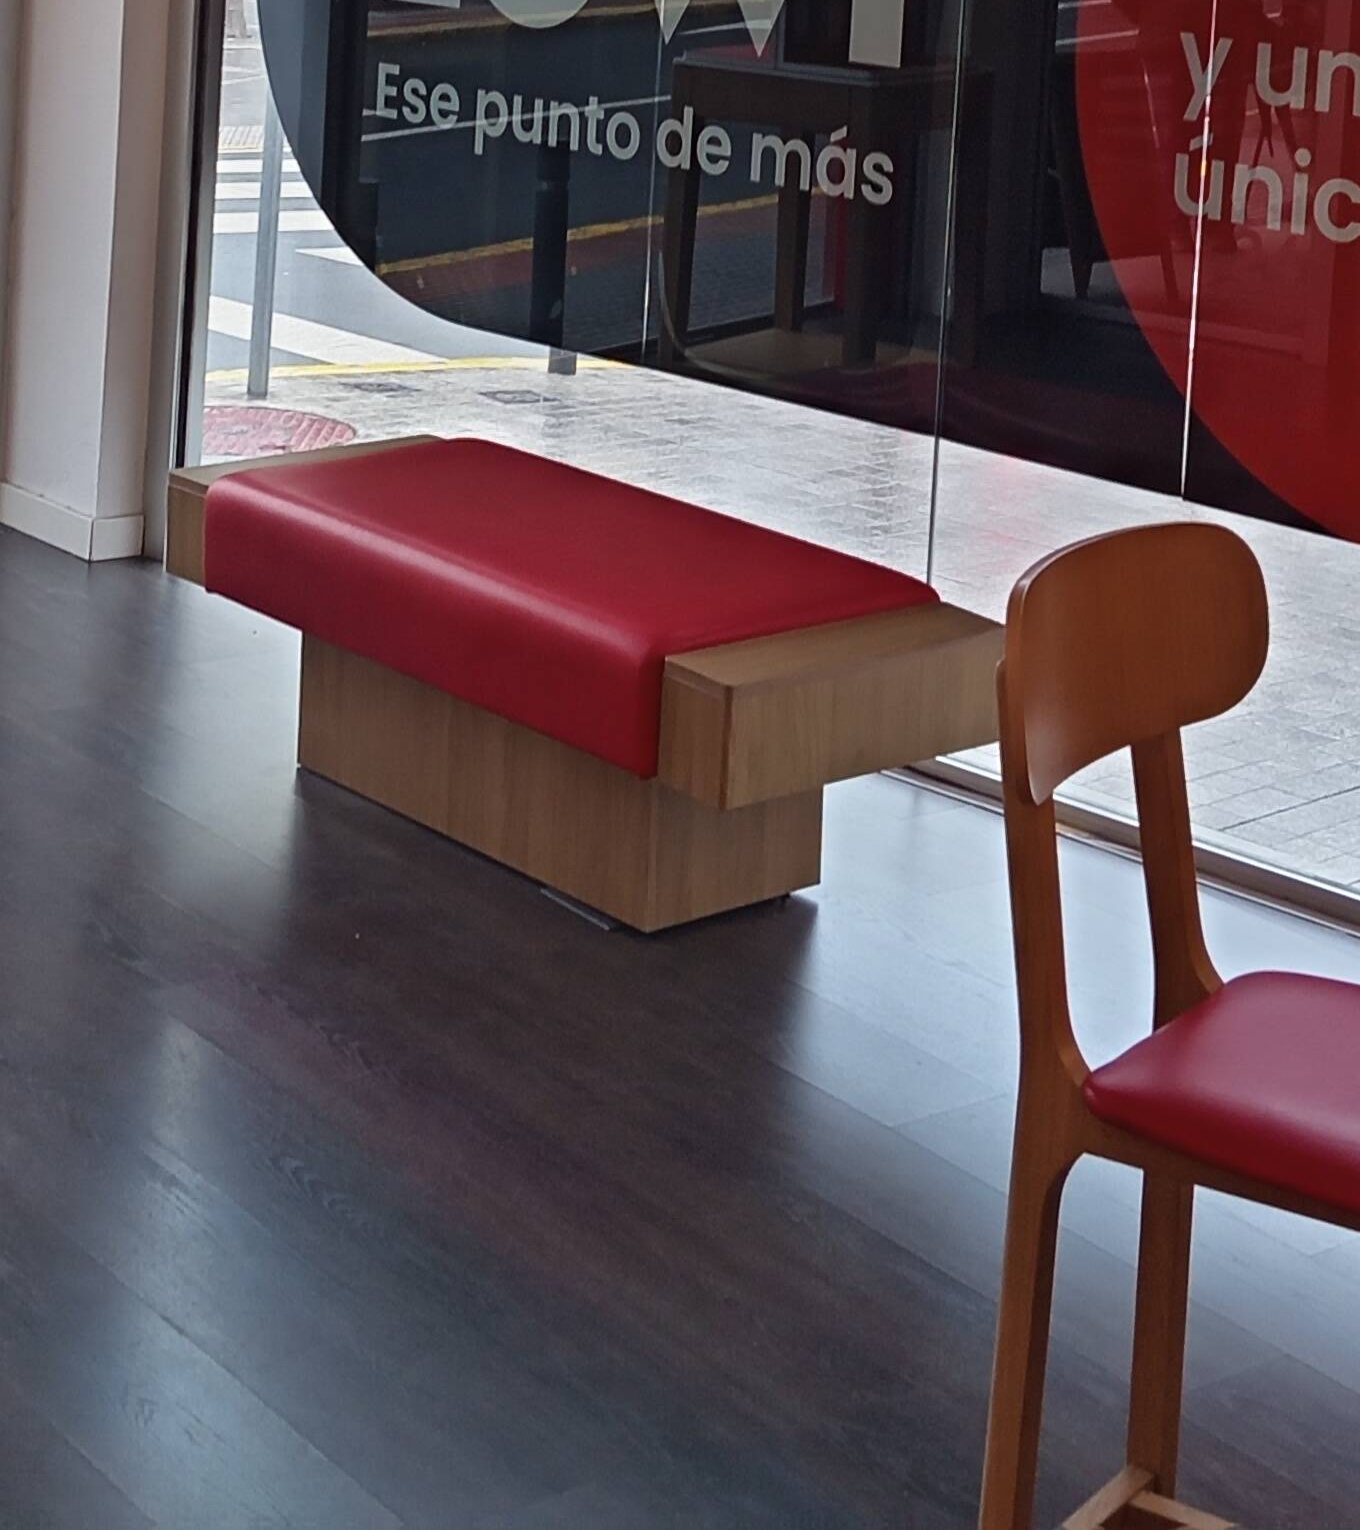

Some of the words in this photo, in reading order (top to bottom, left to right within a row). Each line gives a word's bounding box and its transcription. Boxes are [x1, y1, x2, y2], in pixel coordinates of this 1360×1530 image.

[375, 61, 461, 130] Ese
[473, 92, 640, 161] punto
[656, 106, 733, 176] de
[750, 126, 895, 206] más
[1178, 30, 1233, 123] y
